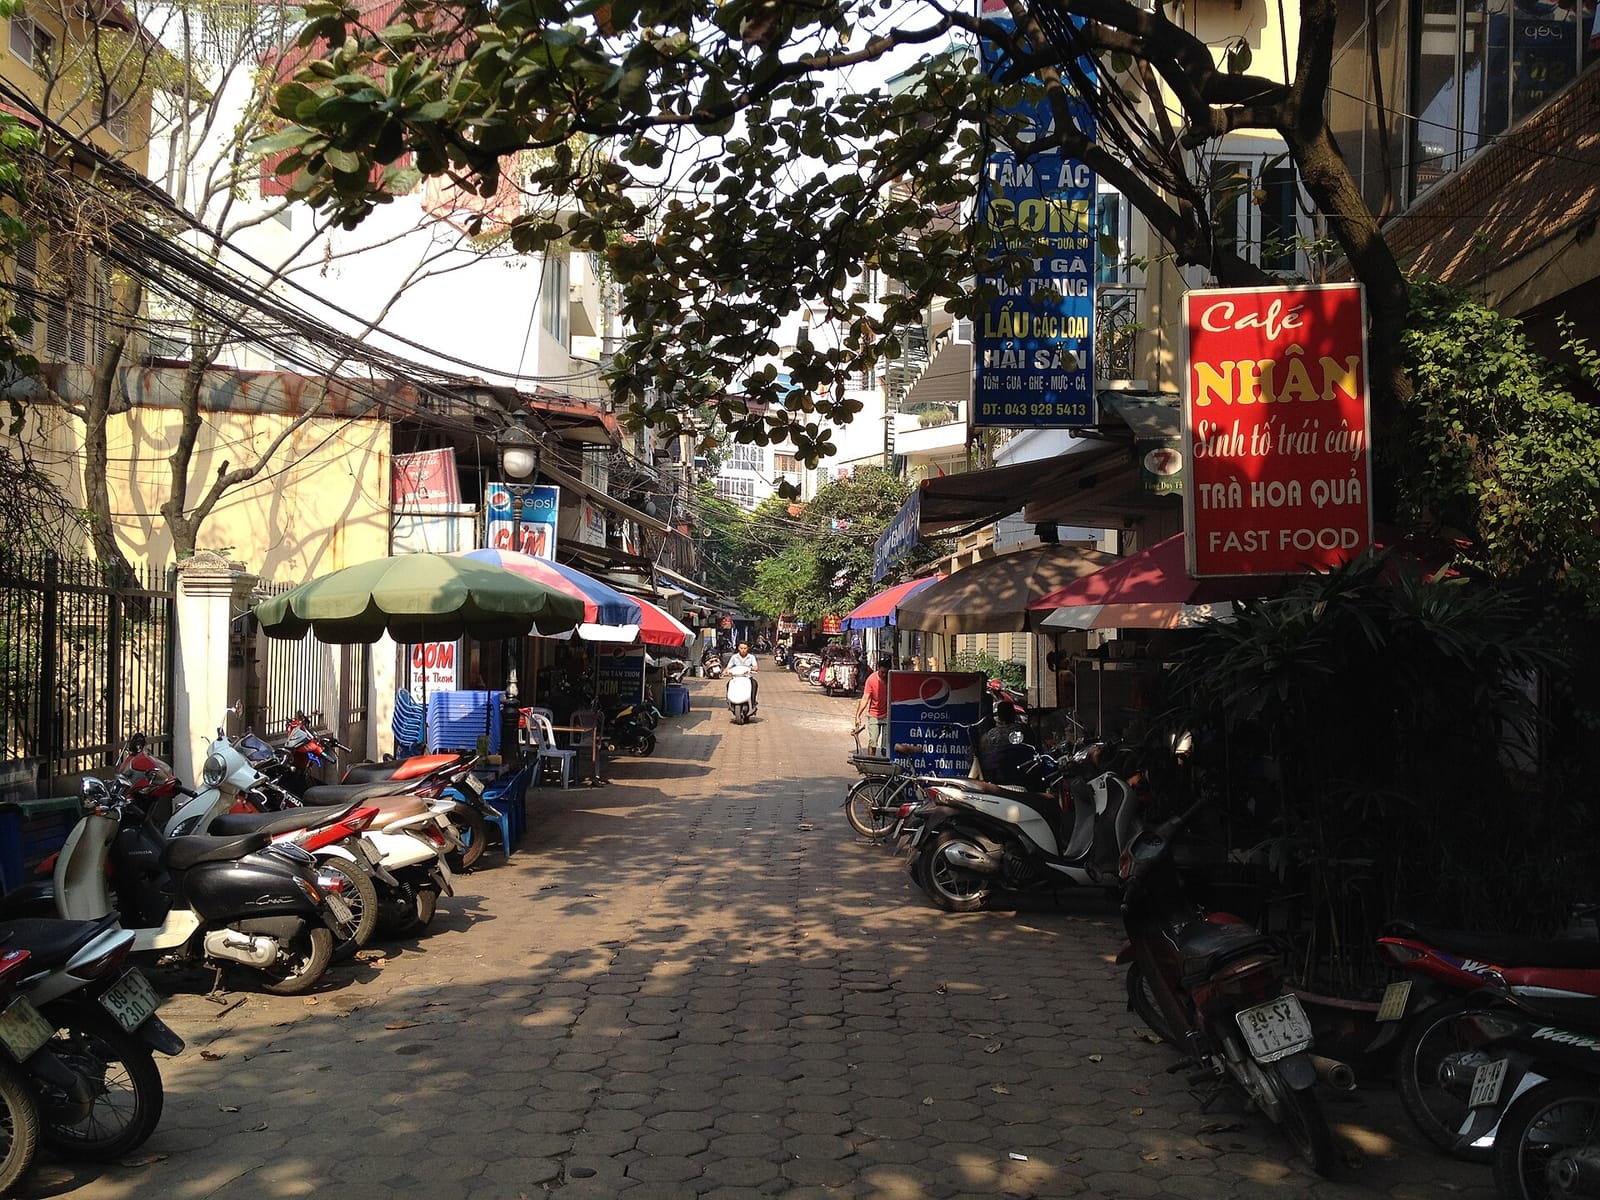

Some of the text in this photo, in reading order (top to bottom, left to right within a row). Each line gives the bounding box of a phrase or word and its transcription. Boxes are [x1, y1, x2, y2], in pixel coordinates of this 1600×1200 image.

[1057, 160, 1090, 188] ÁC
[987, 198, 1089, 233] CƠM
[1051, 256, 1088, 273] GÀ
[984, 301, 1089, 343] LẨU CÁC LOẠI
[1200, 298, 1305, 341] Café
[983, 341, 1087, 370] HẢI SẢN
[1006, 375, 1022, 390] CUA
[1029, 375, 1044, 393] GHẸ
[1051, 374, 1069, 393] MỰC
[1075, 373, 1086, 391] CÁ
[1193, 343, 1361, 407] NHÂN
[982, 403, 1086, 416] ĐT: 043 928 5413
[1192, 414, 1365, 463] Sinh tố trái cây
[1151, 451, 1173, 474] 7
[1200, 468, 1362, 510] TRÀ HOA QUẢ
[519, 497, 554, 510] epsi
[1209, 527, 1360, 553] FAST FOOD
[413, 642, 454, 669] CƠM
[920, 711, 948, 721] pepsi
[910, 726, 923, 738] GÀ
[936, 742, 948, 754] GÀ
[950, 744, 970, 754] RAN
[914, 757, 926, 769] GÀ
